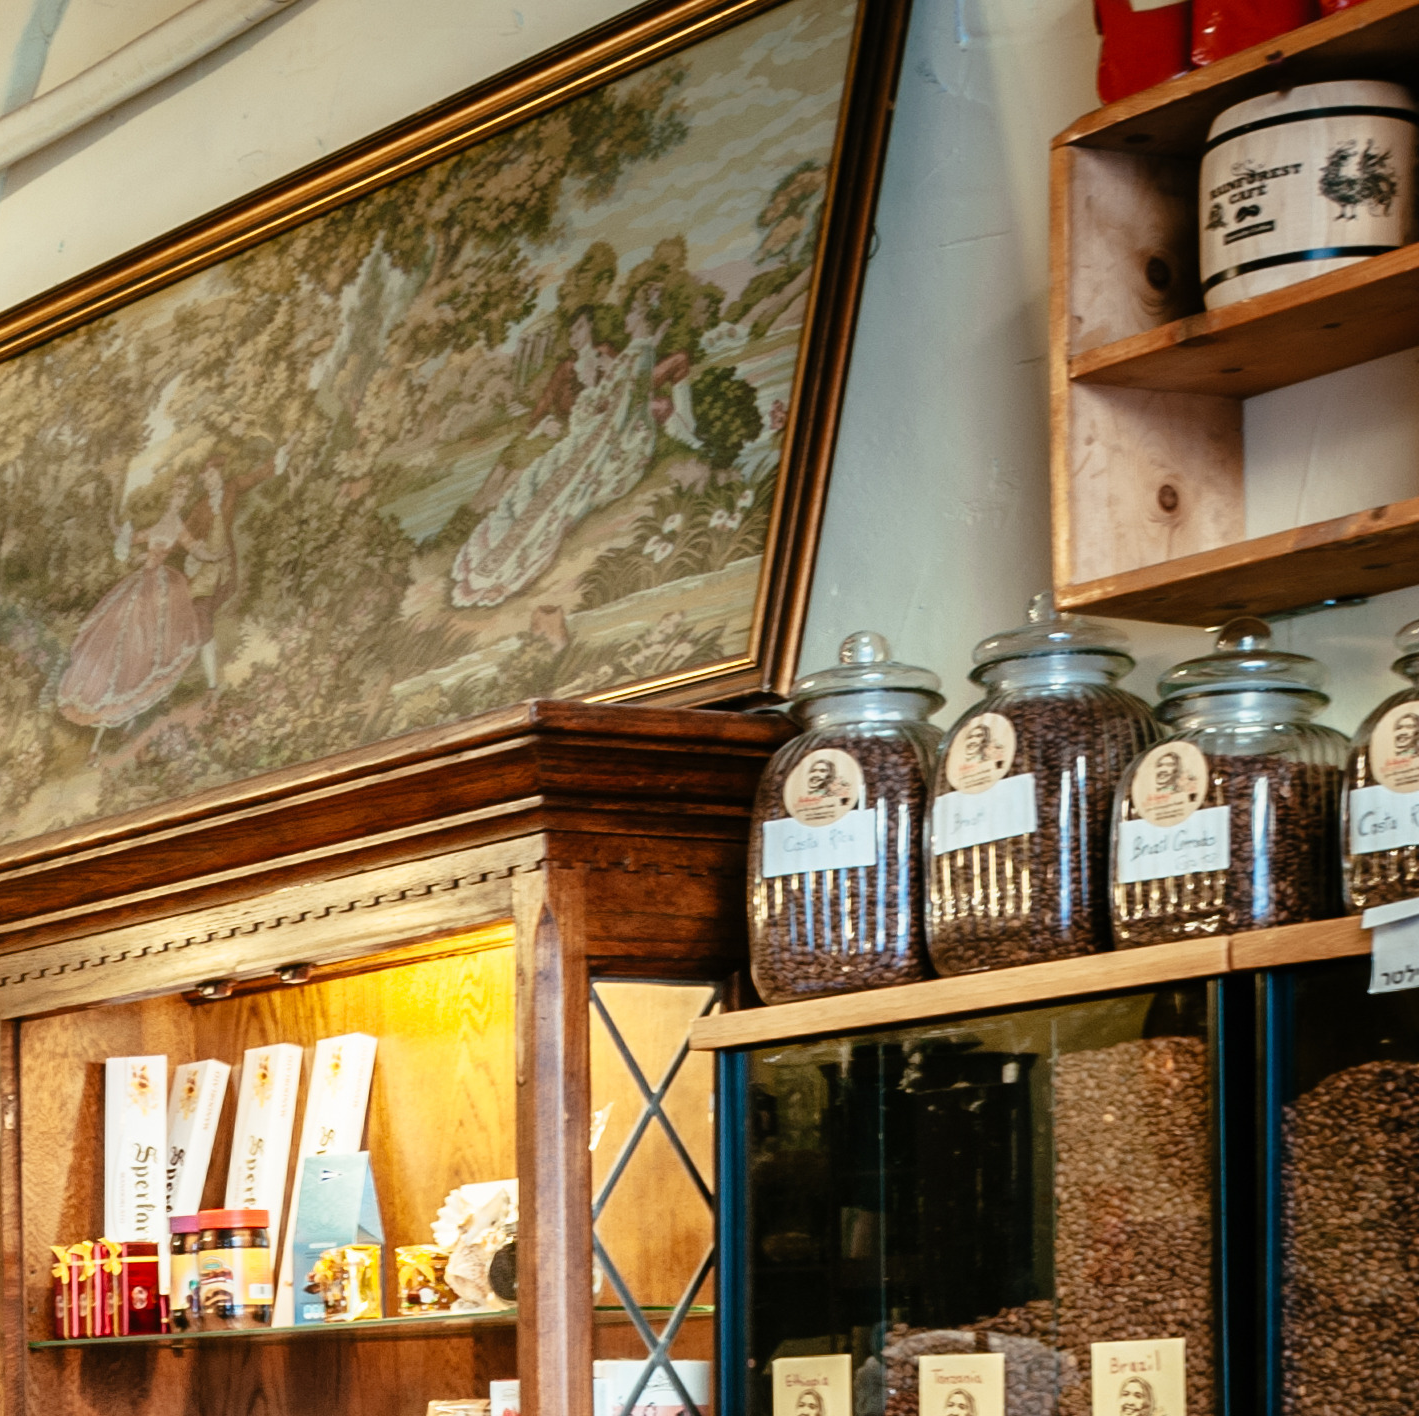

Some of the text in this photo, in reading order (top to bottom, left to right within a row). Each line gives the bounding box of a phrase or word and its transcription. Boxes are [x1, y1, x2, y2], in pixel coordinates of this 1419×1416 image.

[1209, 162, 1302, 200] RAINFOREST
[783, 834, 819, 853] Costa
[1380, 965, 1419, 985] לטר
[1109, 1350, 1161, 1374] Brazil
